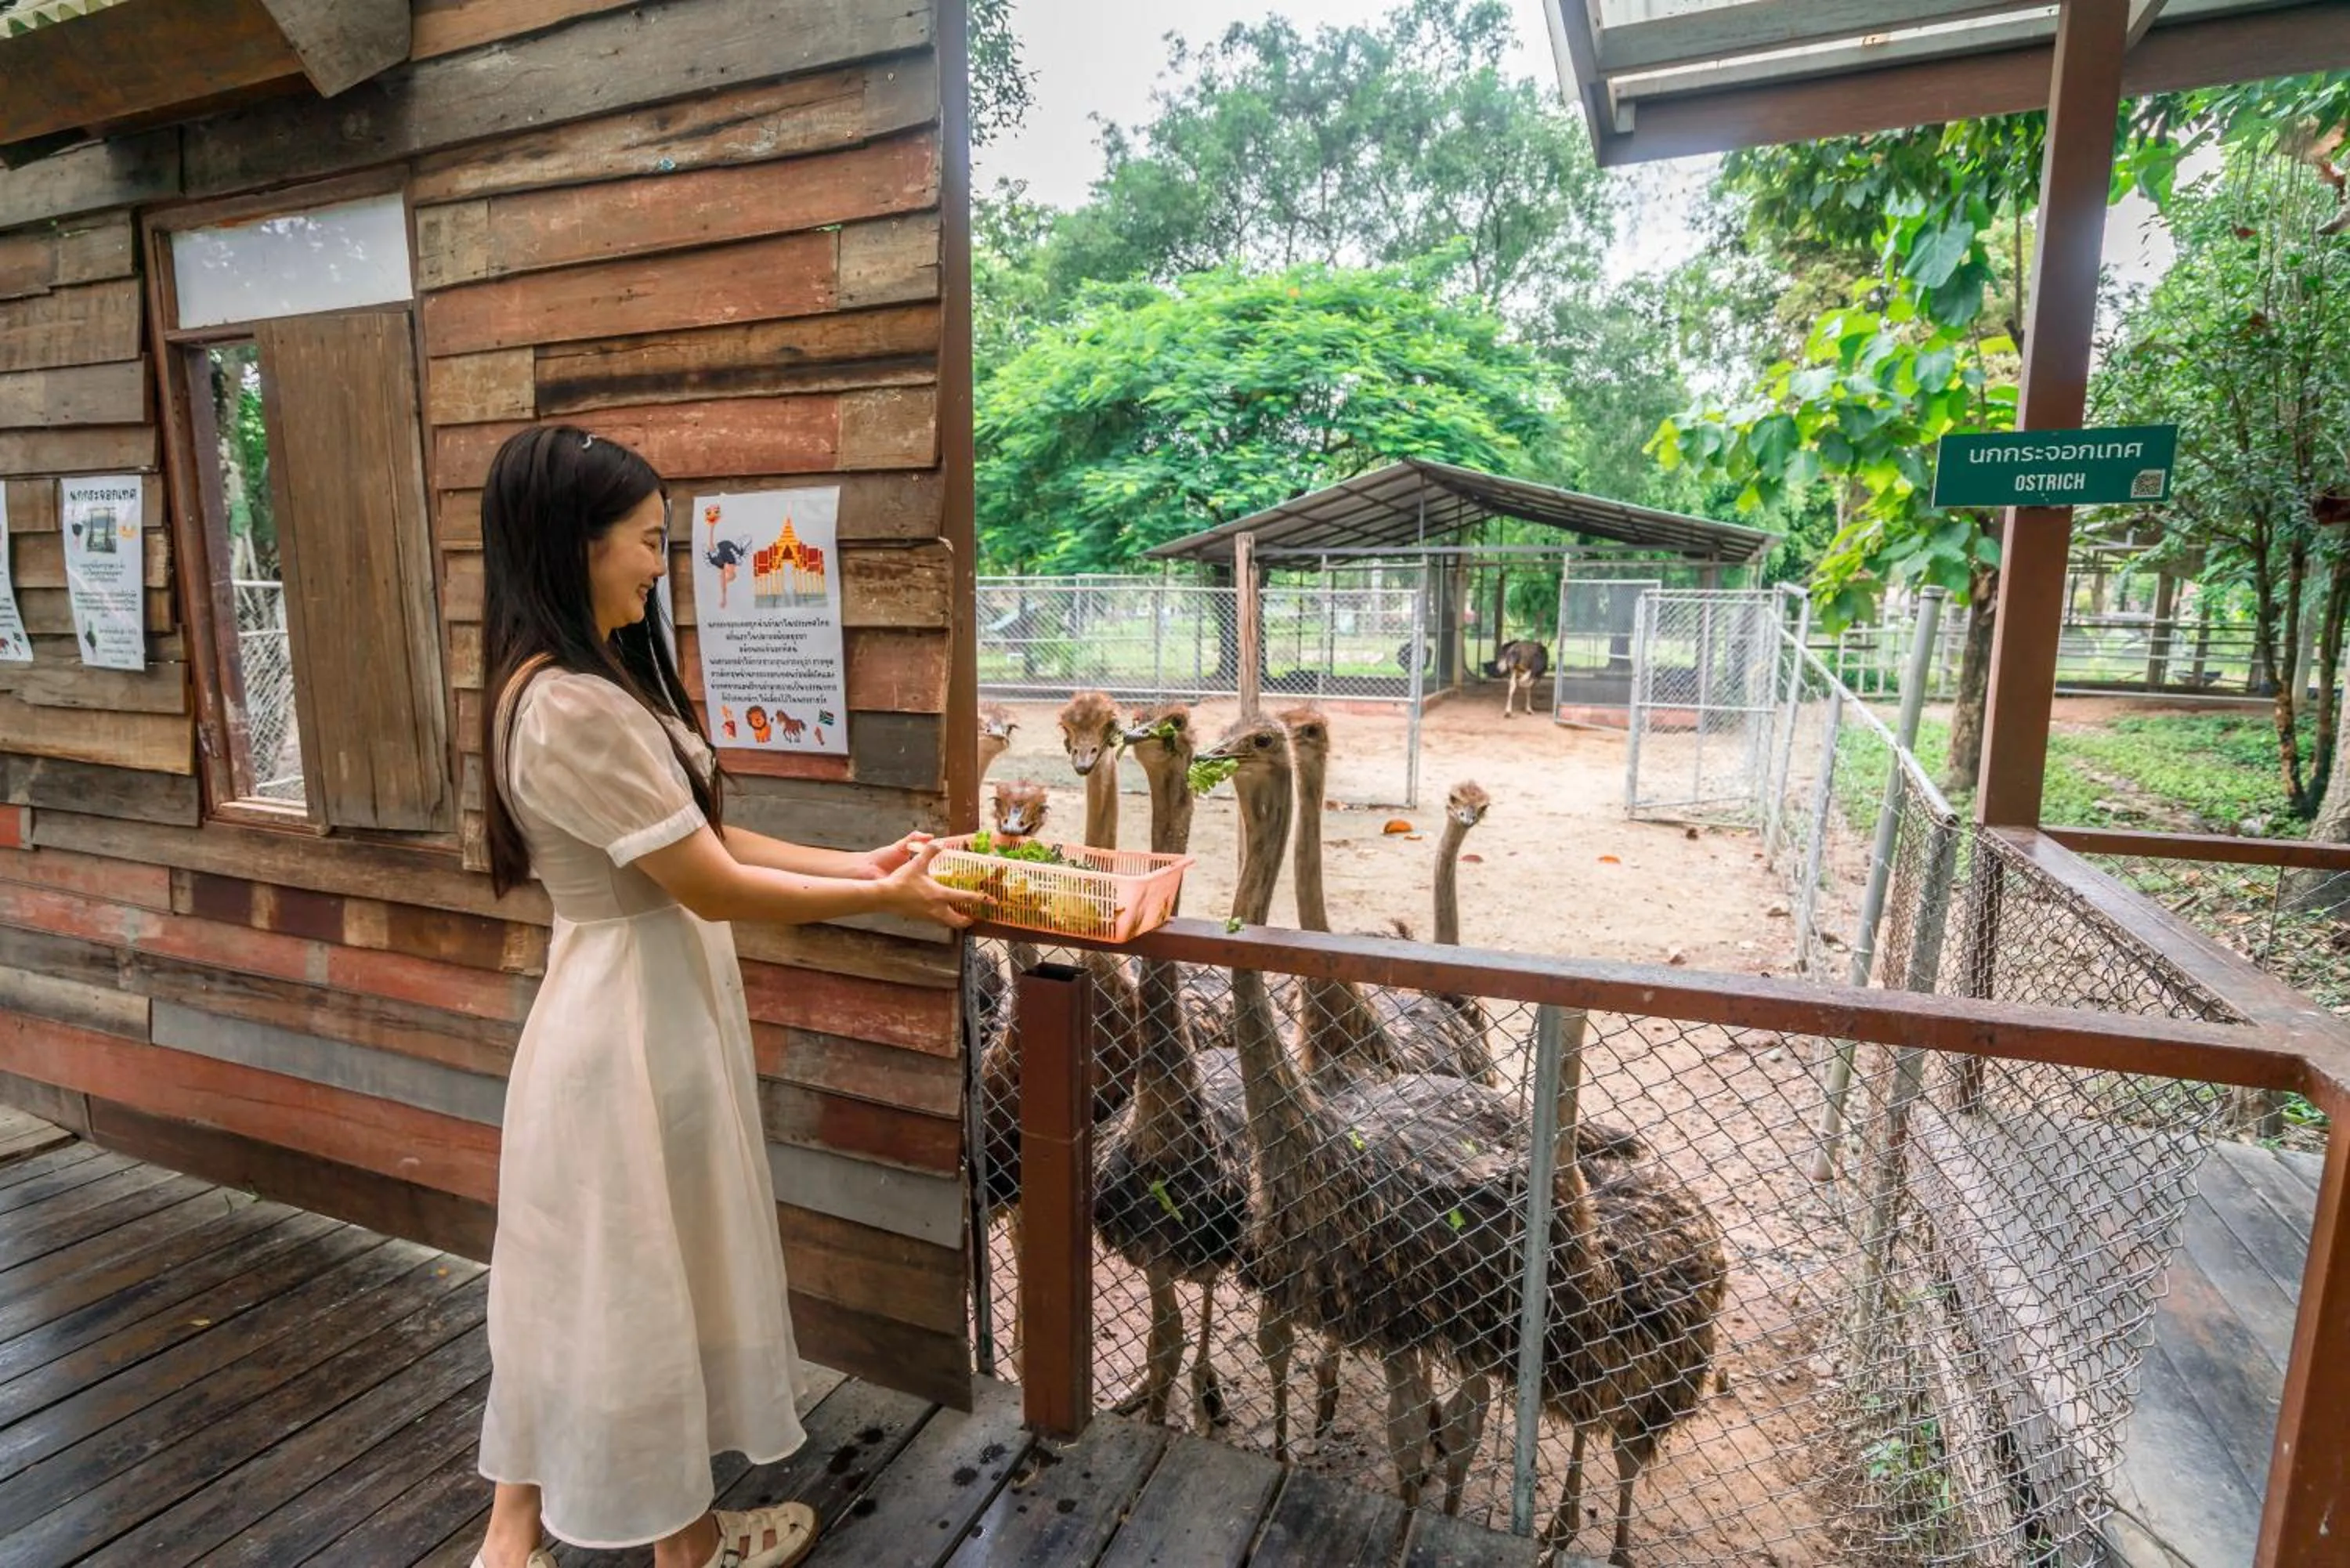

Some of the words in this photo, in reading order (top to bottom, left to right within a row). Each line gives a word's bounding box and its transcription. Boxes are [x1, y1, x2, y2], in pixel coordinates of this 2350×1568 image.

[1969, 443, 2143, 464] นกกระจอกเทศ
[2015, 473, 2086, 491] OSTRICH
